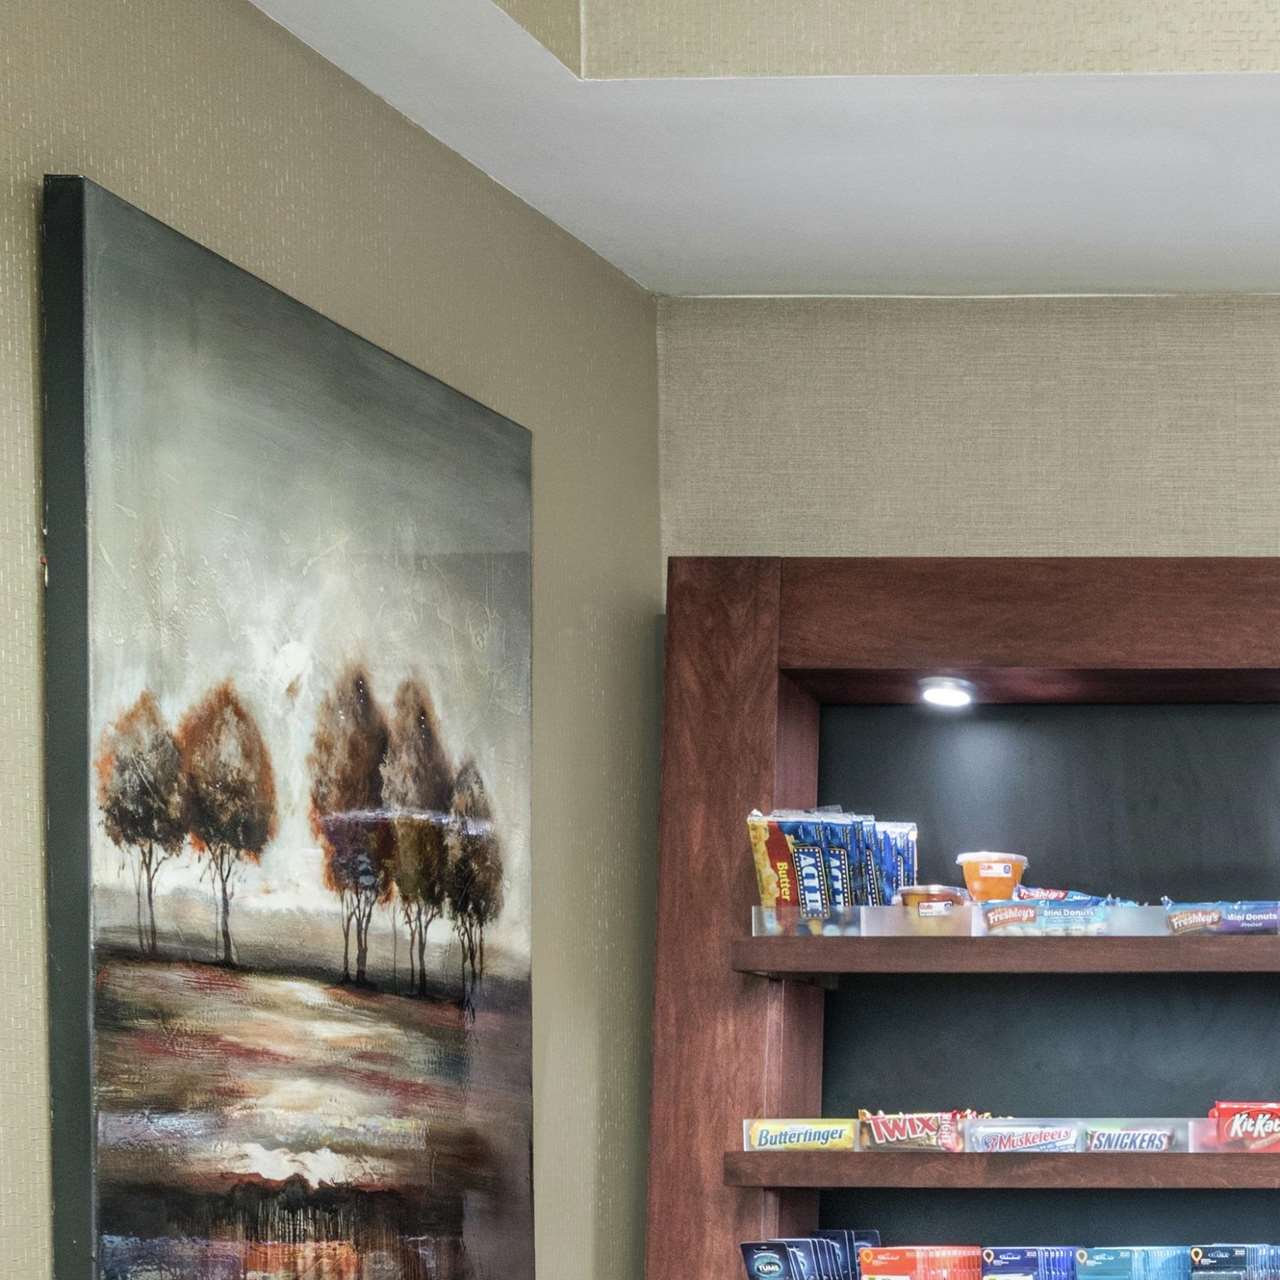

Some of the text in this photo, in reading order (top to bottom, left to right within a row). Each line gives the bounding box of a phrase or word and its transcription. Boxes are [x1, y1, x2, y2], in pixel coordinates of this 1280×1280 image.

[776, 861, 791, 902] Butter
[1061, 909, 1095, 918] Donuts
[1246, 912, 1278, 921] Donuts
[757, 1126, 845, 1147] Butterfinger
[1093, 1130, 1168, 1149] SNICKERS
[758, 1264, 779, 1273] TUMS
